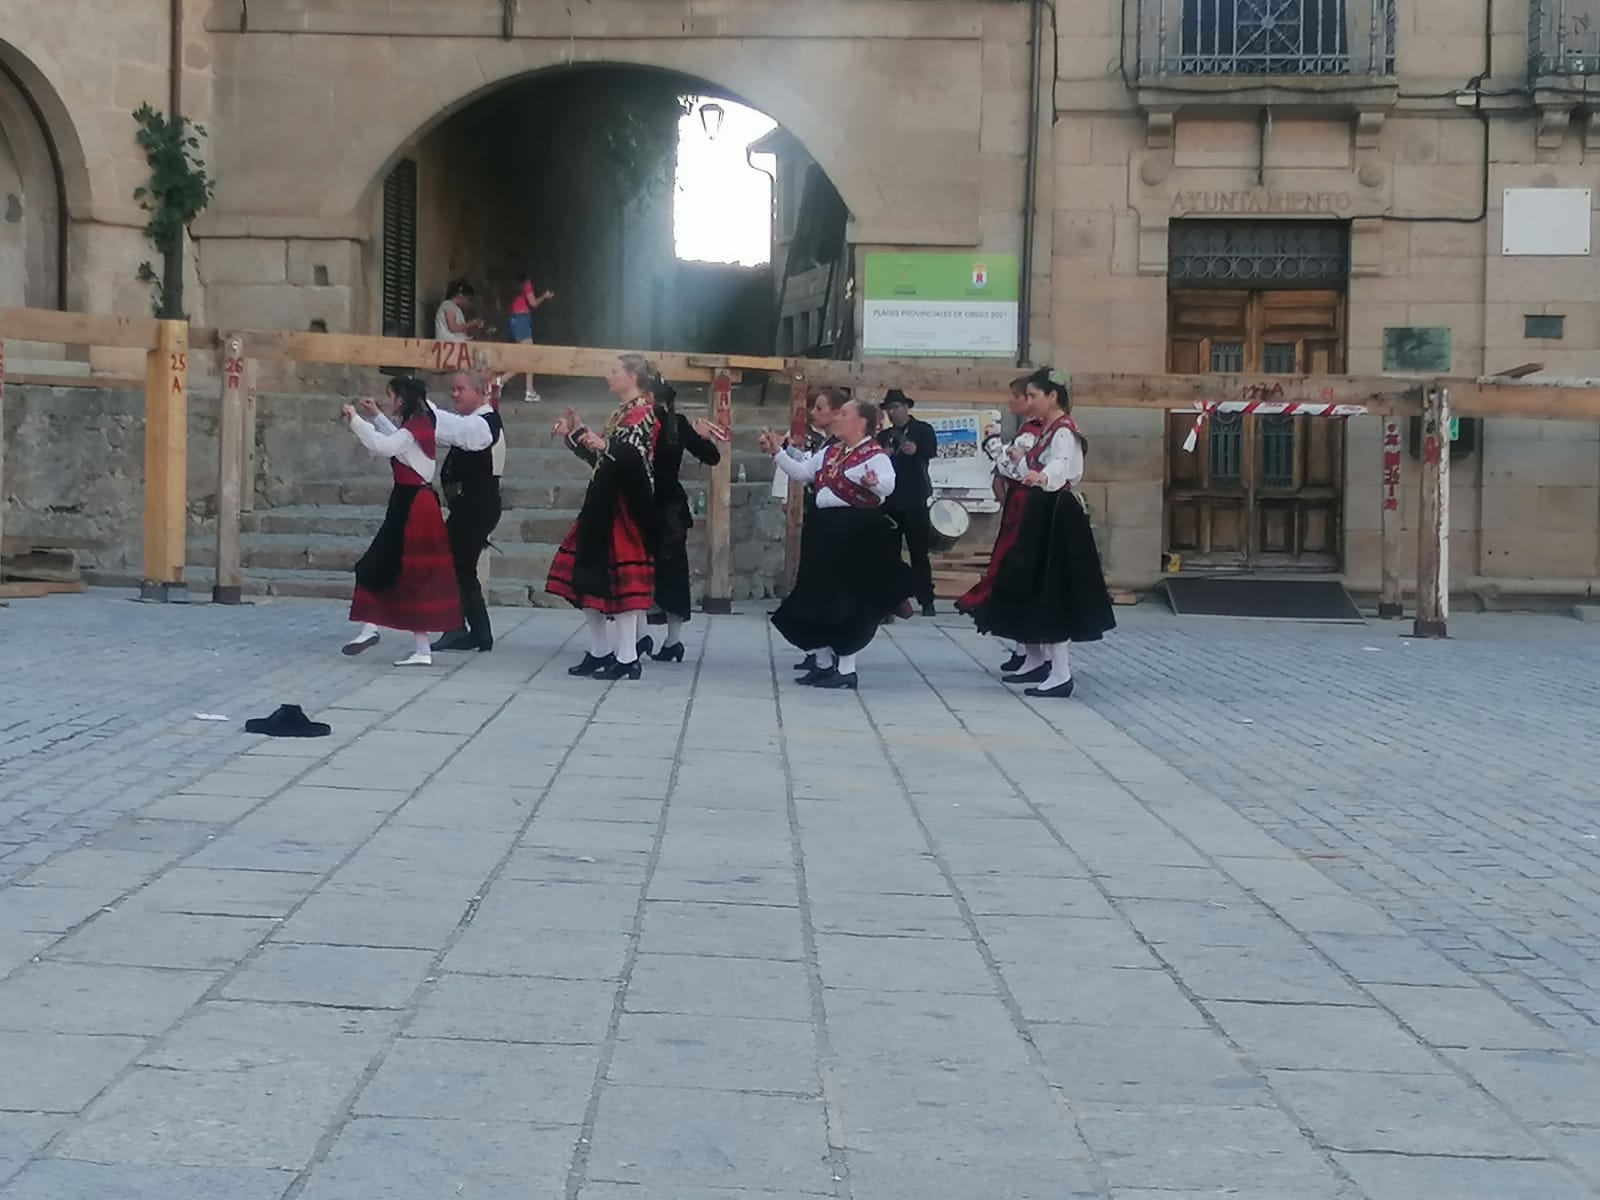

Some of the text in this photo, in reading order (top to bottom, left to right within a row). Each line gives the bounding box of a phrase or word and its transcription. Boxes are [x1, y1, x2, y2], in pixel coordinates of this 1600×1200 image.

[1170, 191, 1351, 212] AYUNTAMIENTO
[873, 309, 900, 318] PLANES
[901, 309, 951, 318] PROVINCIALES
[990, 311, 1007, 319] 2021
[171, 353, 186, 371] 25
[431, 341, 471, 369] 12A
[172, 376, 181, 394] A
